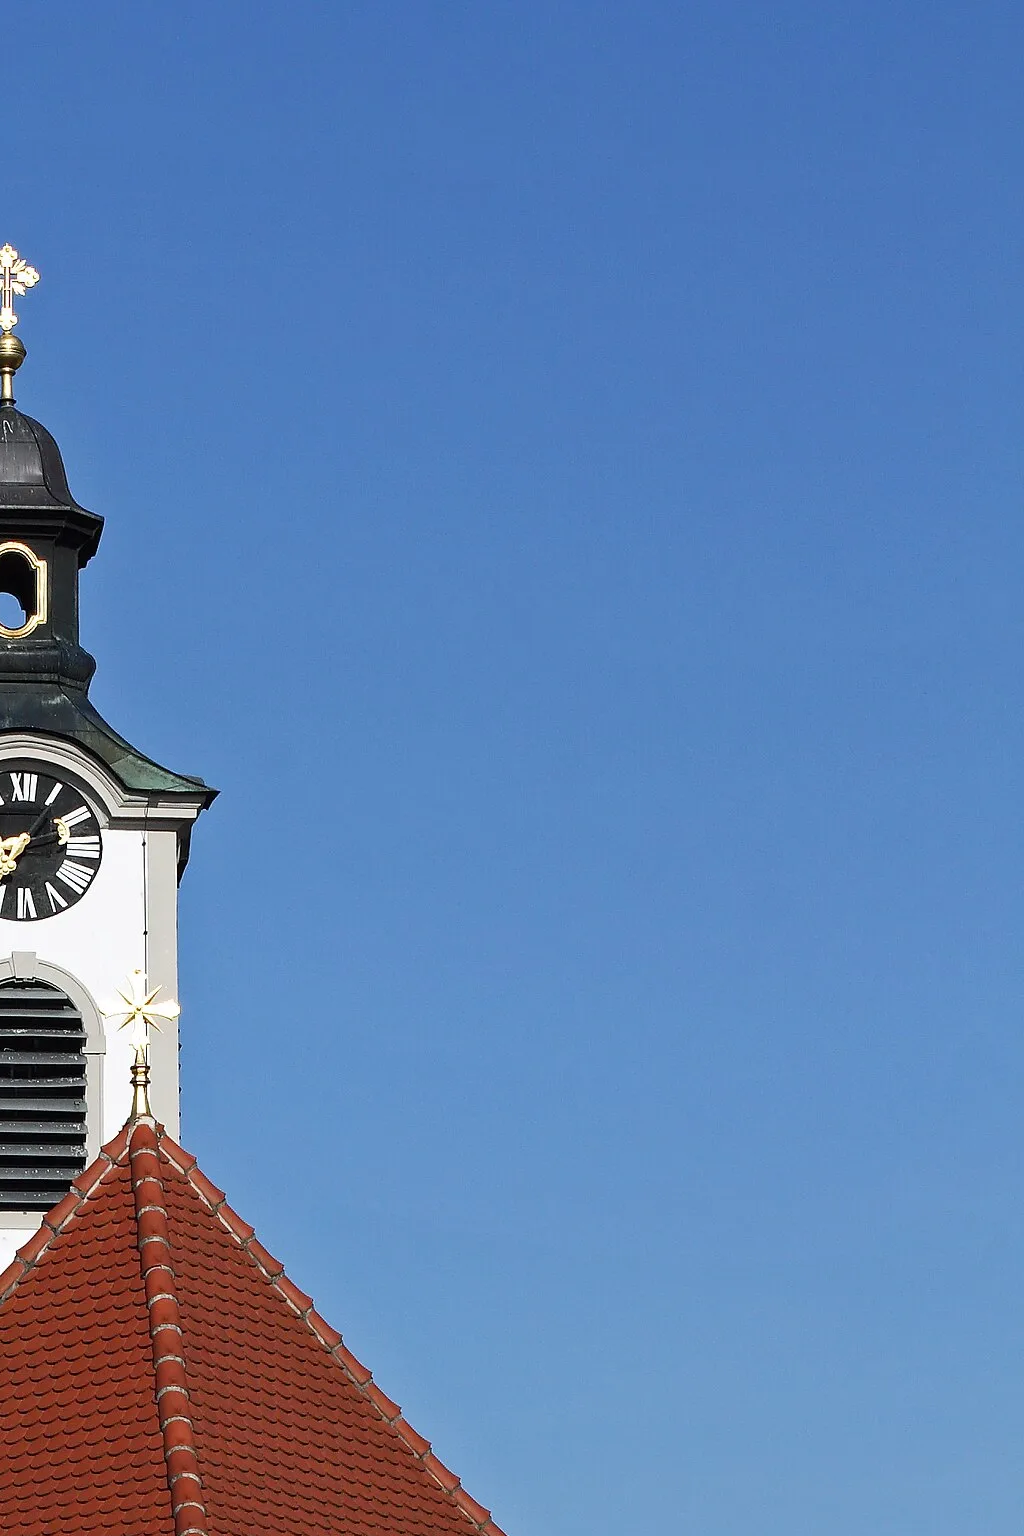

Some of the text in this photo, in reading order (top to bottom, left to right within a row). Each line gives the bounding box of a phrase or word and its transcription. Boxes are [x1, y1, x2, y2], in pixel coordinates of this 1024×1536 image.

[10, 772, 38, 802] XII
[65, 836, 100, 859] III
[17, 887, 38, 919] VI
[44, 881, 69, 912] V
